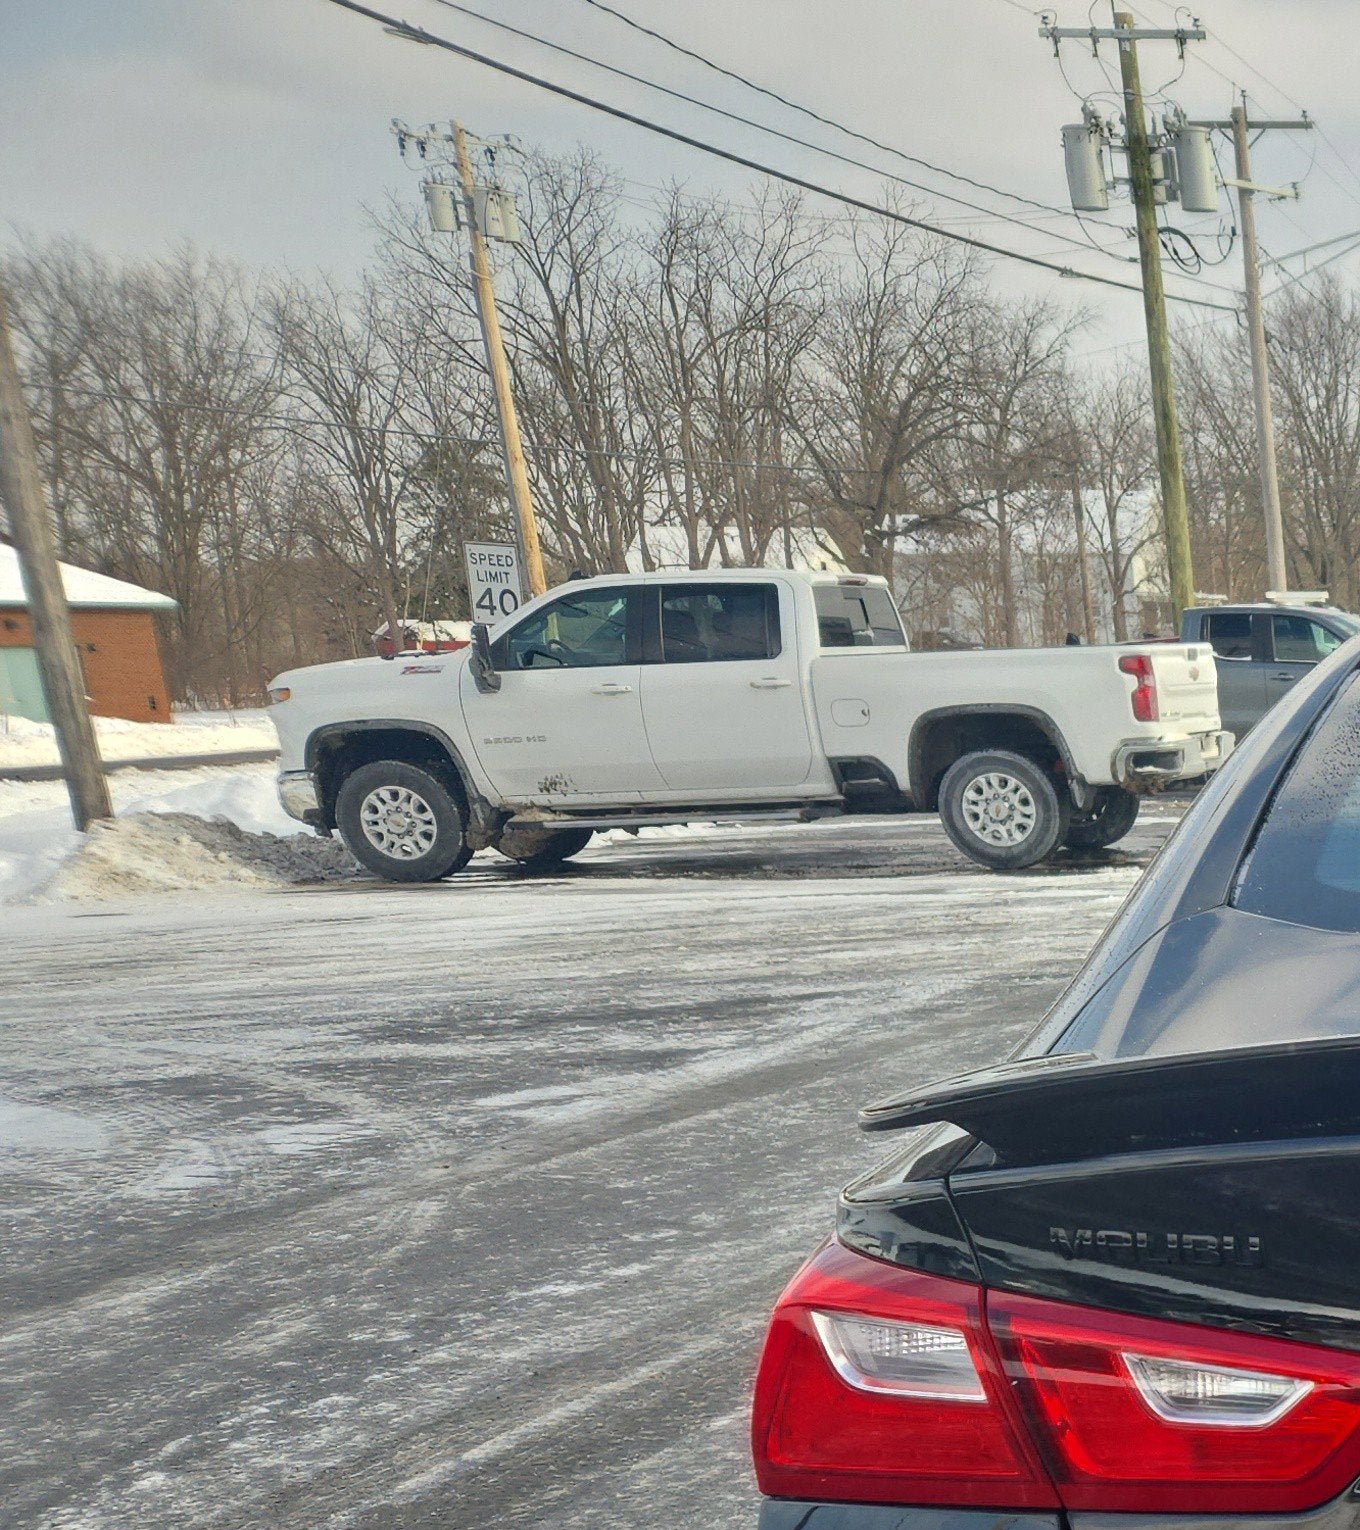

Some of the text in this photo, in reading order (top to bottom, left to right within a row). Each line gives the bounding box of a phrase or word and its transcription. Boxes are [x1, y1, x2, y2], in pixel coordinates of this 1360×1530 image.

[469, 552, 514, 567] SPEED
[476, 570, 510, 583] LIMIT
[475, 587, 519, 616] 40
[1049, 1226, 1264, 1267] MALIBU
